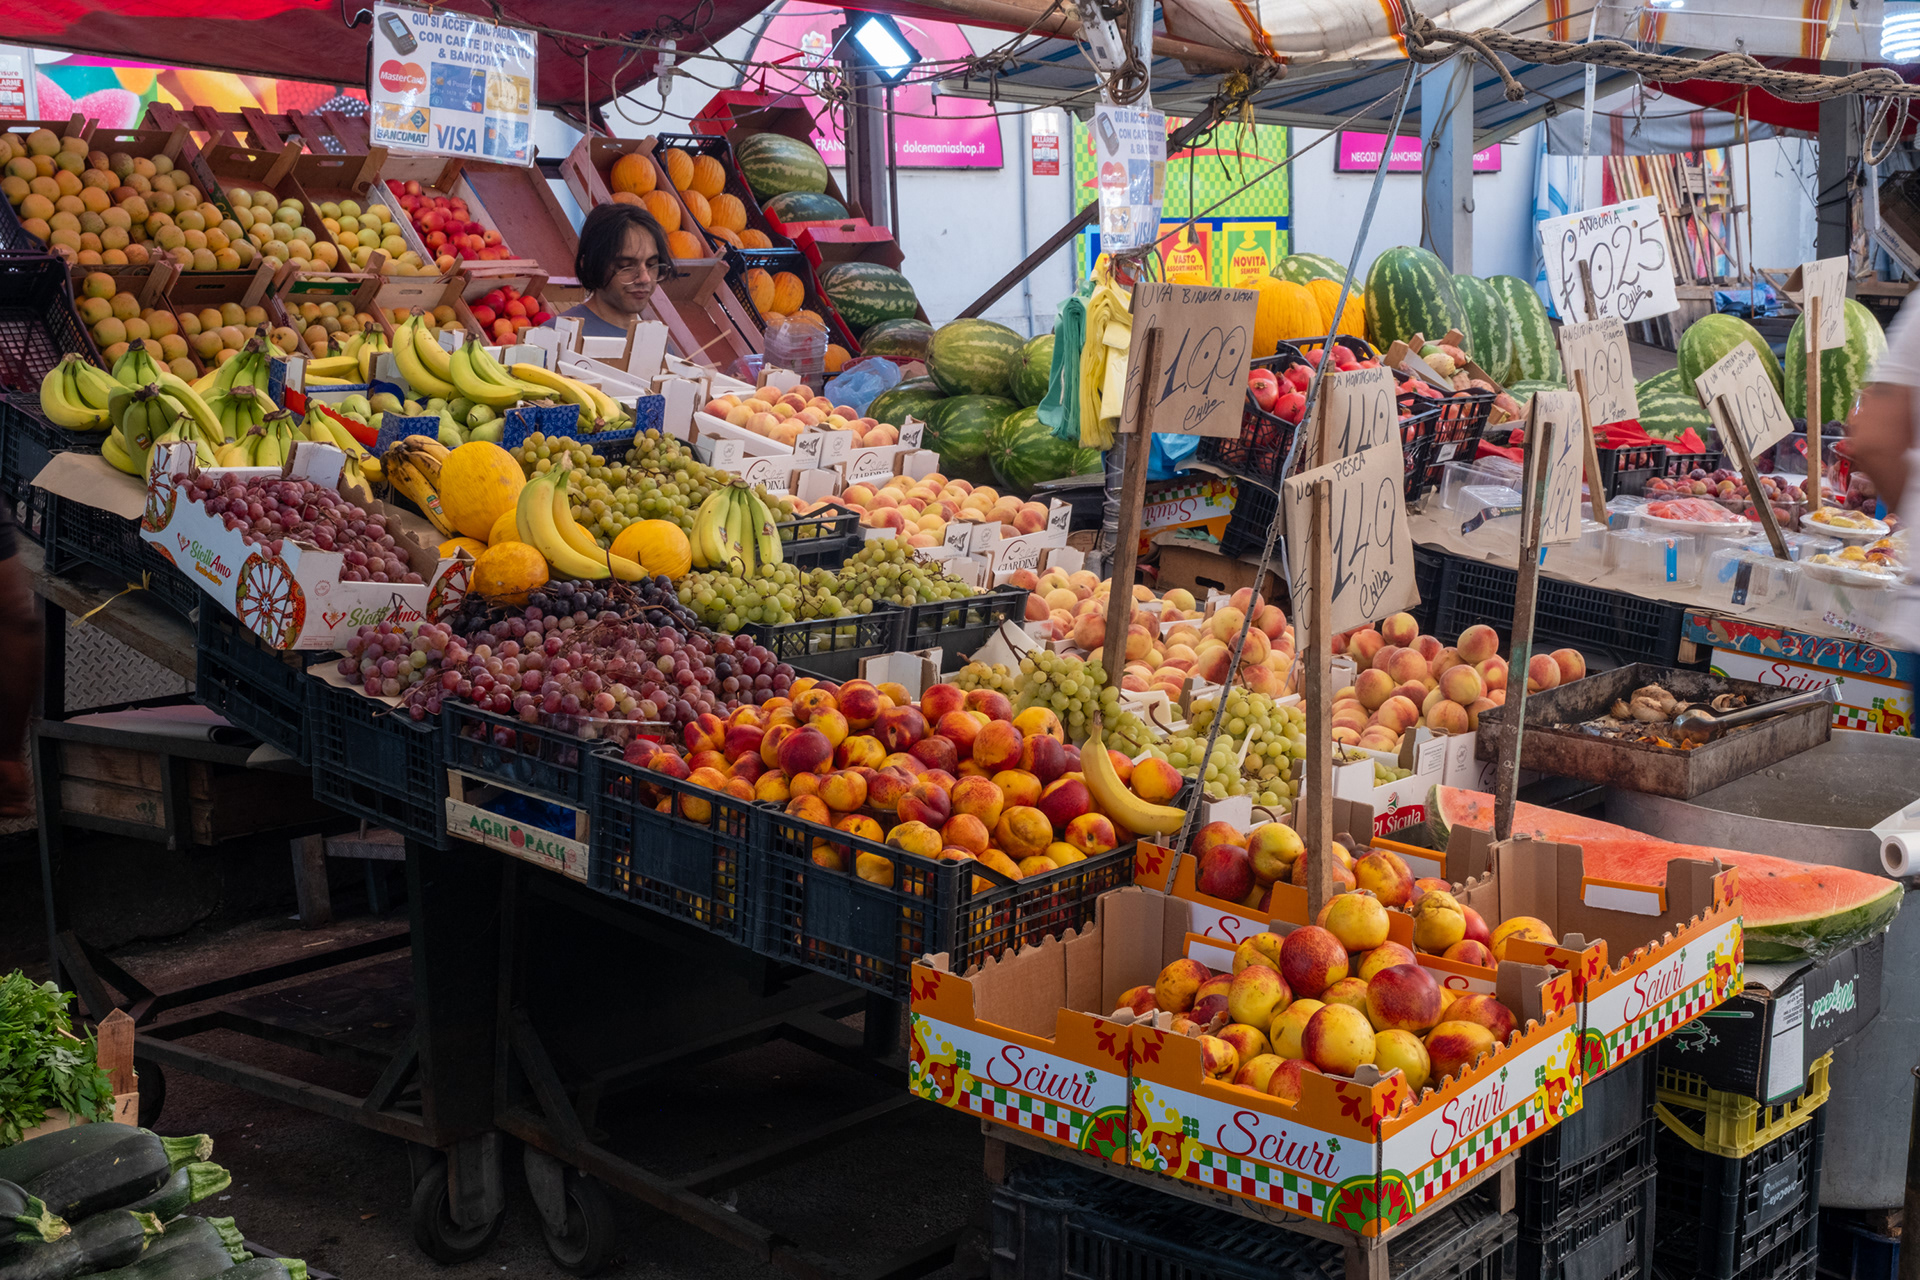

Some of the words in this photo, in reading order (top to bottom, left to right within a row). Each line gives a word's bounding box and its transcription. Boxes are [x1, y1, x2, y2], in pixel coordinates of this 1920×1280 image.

[412, 13, 429, 27] QUI
[430, 16, 440, 28] SI
[419, 31, 442, 44] CON
[446, 34, 480, 50] CARTE
[482, 40, 493, 51] DI
[438, 48, 446, 58] &
[380, 70, 426, 85] MasterCard
[376, 128, 428, 144] BANCOMAT
[434, 124, 477, 154] VISA
[1118, 128, 1132, 139] CON
[903, 140, 985, 157] dolcemaniashop.it
[1351, 152, 1376, 162] NEGOZI
[1578, 210, 1622, 238] ANGURIA
[1173, 254, 1196, 264] VASTO
[1142, 283, 1172, 308] UVA
[1182, 288, 1222, 304] BIANCA
[1154, 325, 1247, 408] 1,99
[1333, 452, 1366, 484] PESCA
[1331, 477, 1396, 606] 1,49
[190, 540, 232, 578] SiciliAmo
[1386, 808, 1422, 834] Sicula
[470, 814, 508, 842] AGRI
[525, 834, 566, 861] PACK
[1623, 947, 1687, 1024] Sciuri
[986, 1044, 1098, 1108] Sciuri
[1430, 1066, 1509, 1159] Sciuri
[1216, 1110, 1342, 1179] Sciuri
